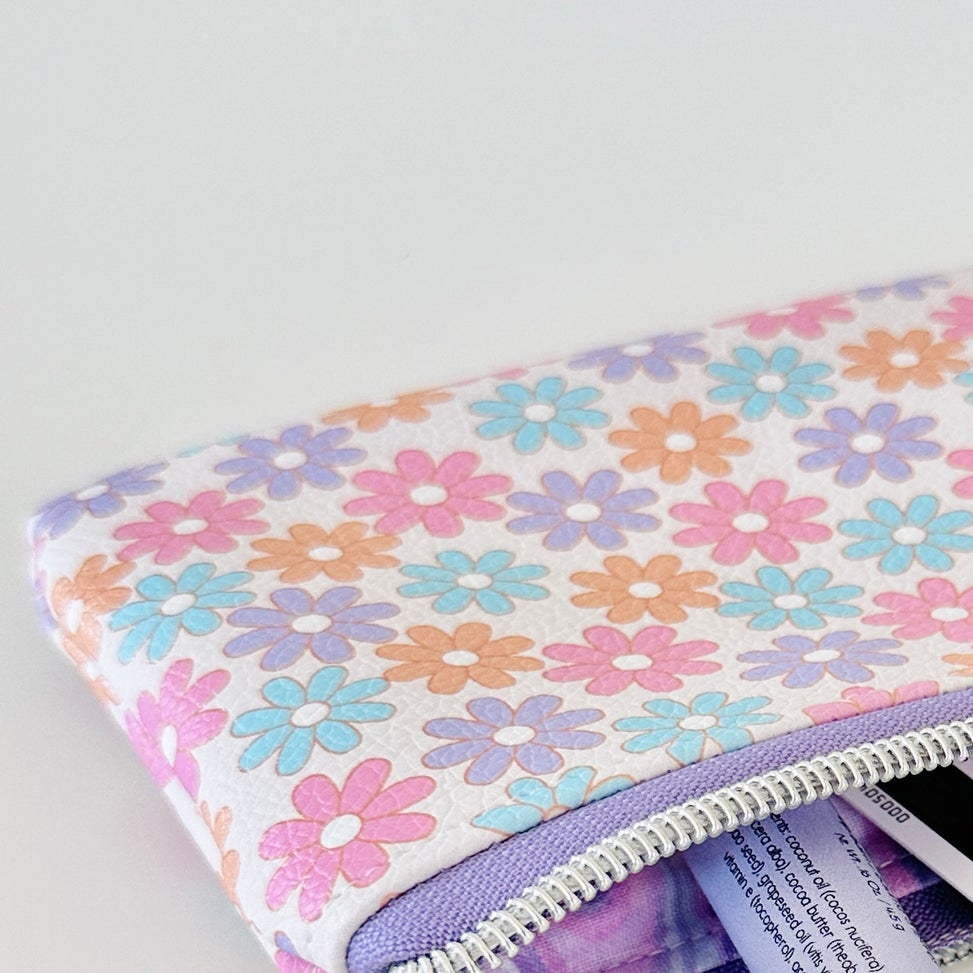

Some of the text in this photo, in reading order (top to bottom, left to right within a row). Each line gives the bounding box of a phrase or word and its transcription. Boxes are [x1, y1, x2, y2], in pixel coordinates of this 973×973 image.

[722, 850, 748, 890] vitamin
[739, 843, 766, 878] seed),
[784, 834, 821, 877] coconut
[744, 885, 754, 898] e
[811, 875, 832, 890] oil
[755, 873, 804, 931] grapeseed
[783, 871, 812, 908] cocoa
[805, 902, 835, 938] butter
[818, 889, 851, 925] (cocos
[748, 892, 796, 962] (tocopherol),
[794, 927, 812, 944] oil
[890, 917, 906, 932] g
[801, 940, 824, 968] (vitis
